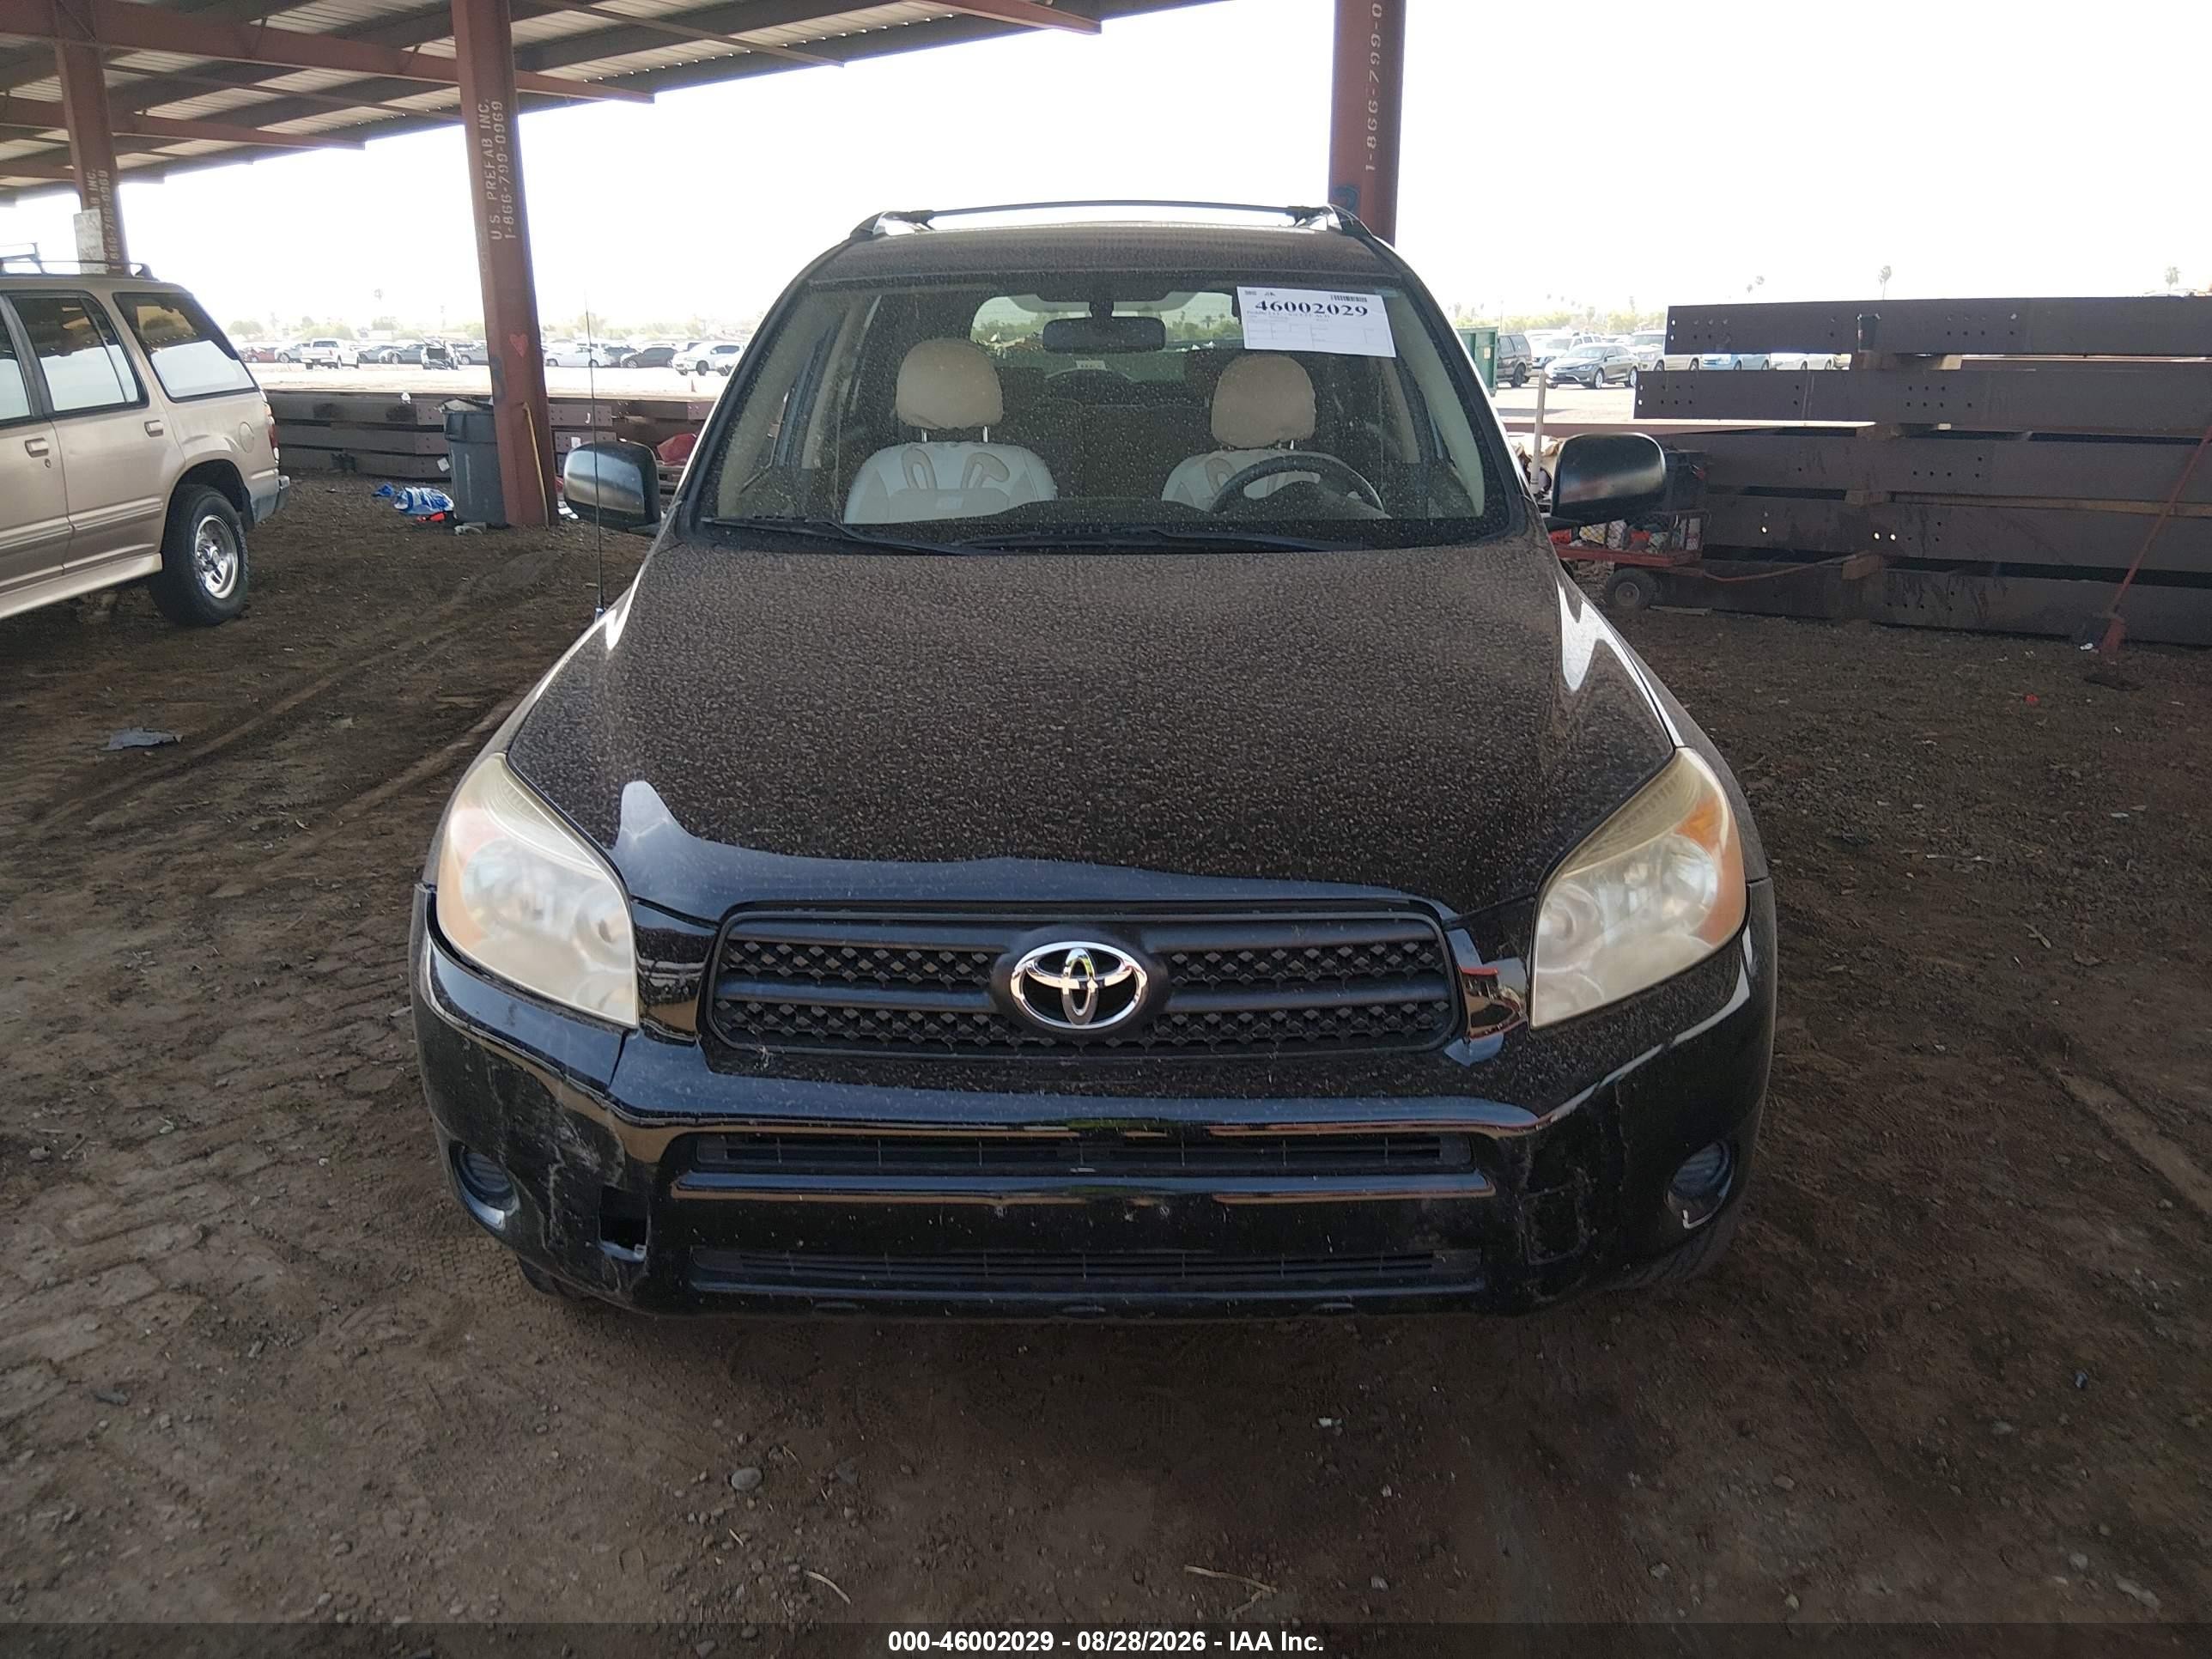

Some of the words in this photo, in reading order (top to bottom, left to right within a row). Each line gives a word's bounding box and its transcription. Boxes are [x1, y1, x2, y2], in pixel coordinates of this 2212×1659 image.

[477, 97, 491, 129] INC.
[481, 138, 498, 200] PREFAB
[491, 100, 516, 239] 1-866-799-0969
[489, 210, 502, 240] U.S.
[1255, 300, 1368, 317] 46002029
